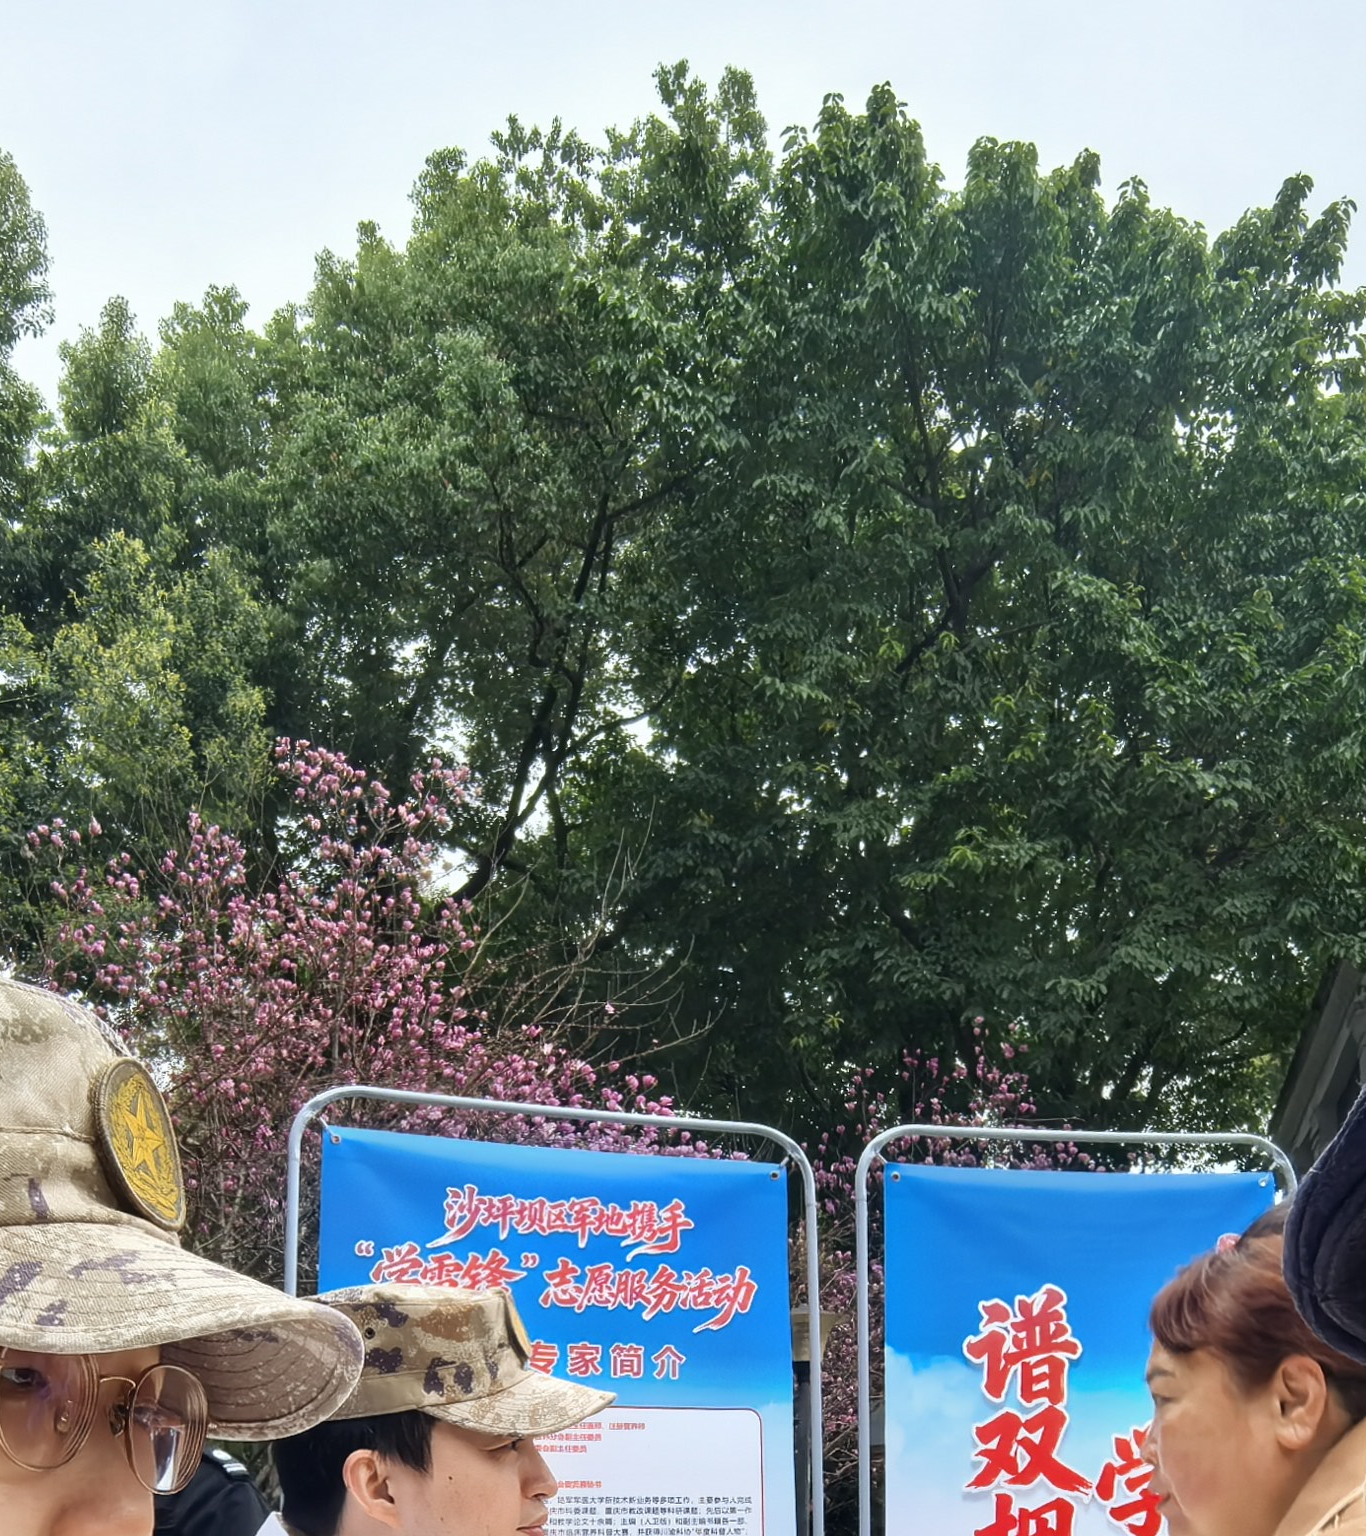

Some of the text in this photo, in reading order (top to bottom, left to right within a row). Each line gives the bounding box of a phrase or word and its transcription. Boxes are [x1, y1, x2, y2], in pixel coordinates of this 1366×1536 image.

[428, 1185, 693, 1261] 沙坪坝区军地携手
